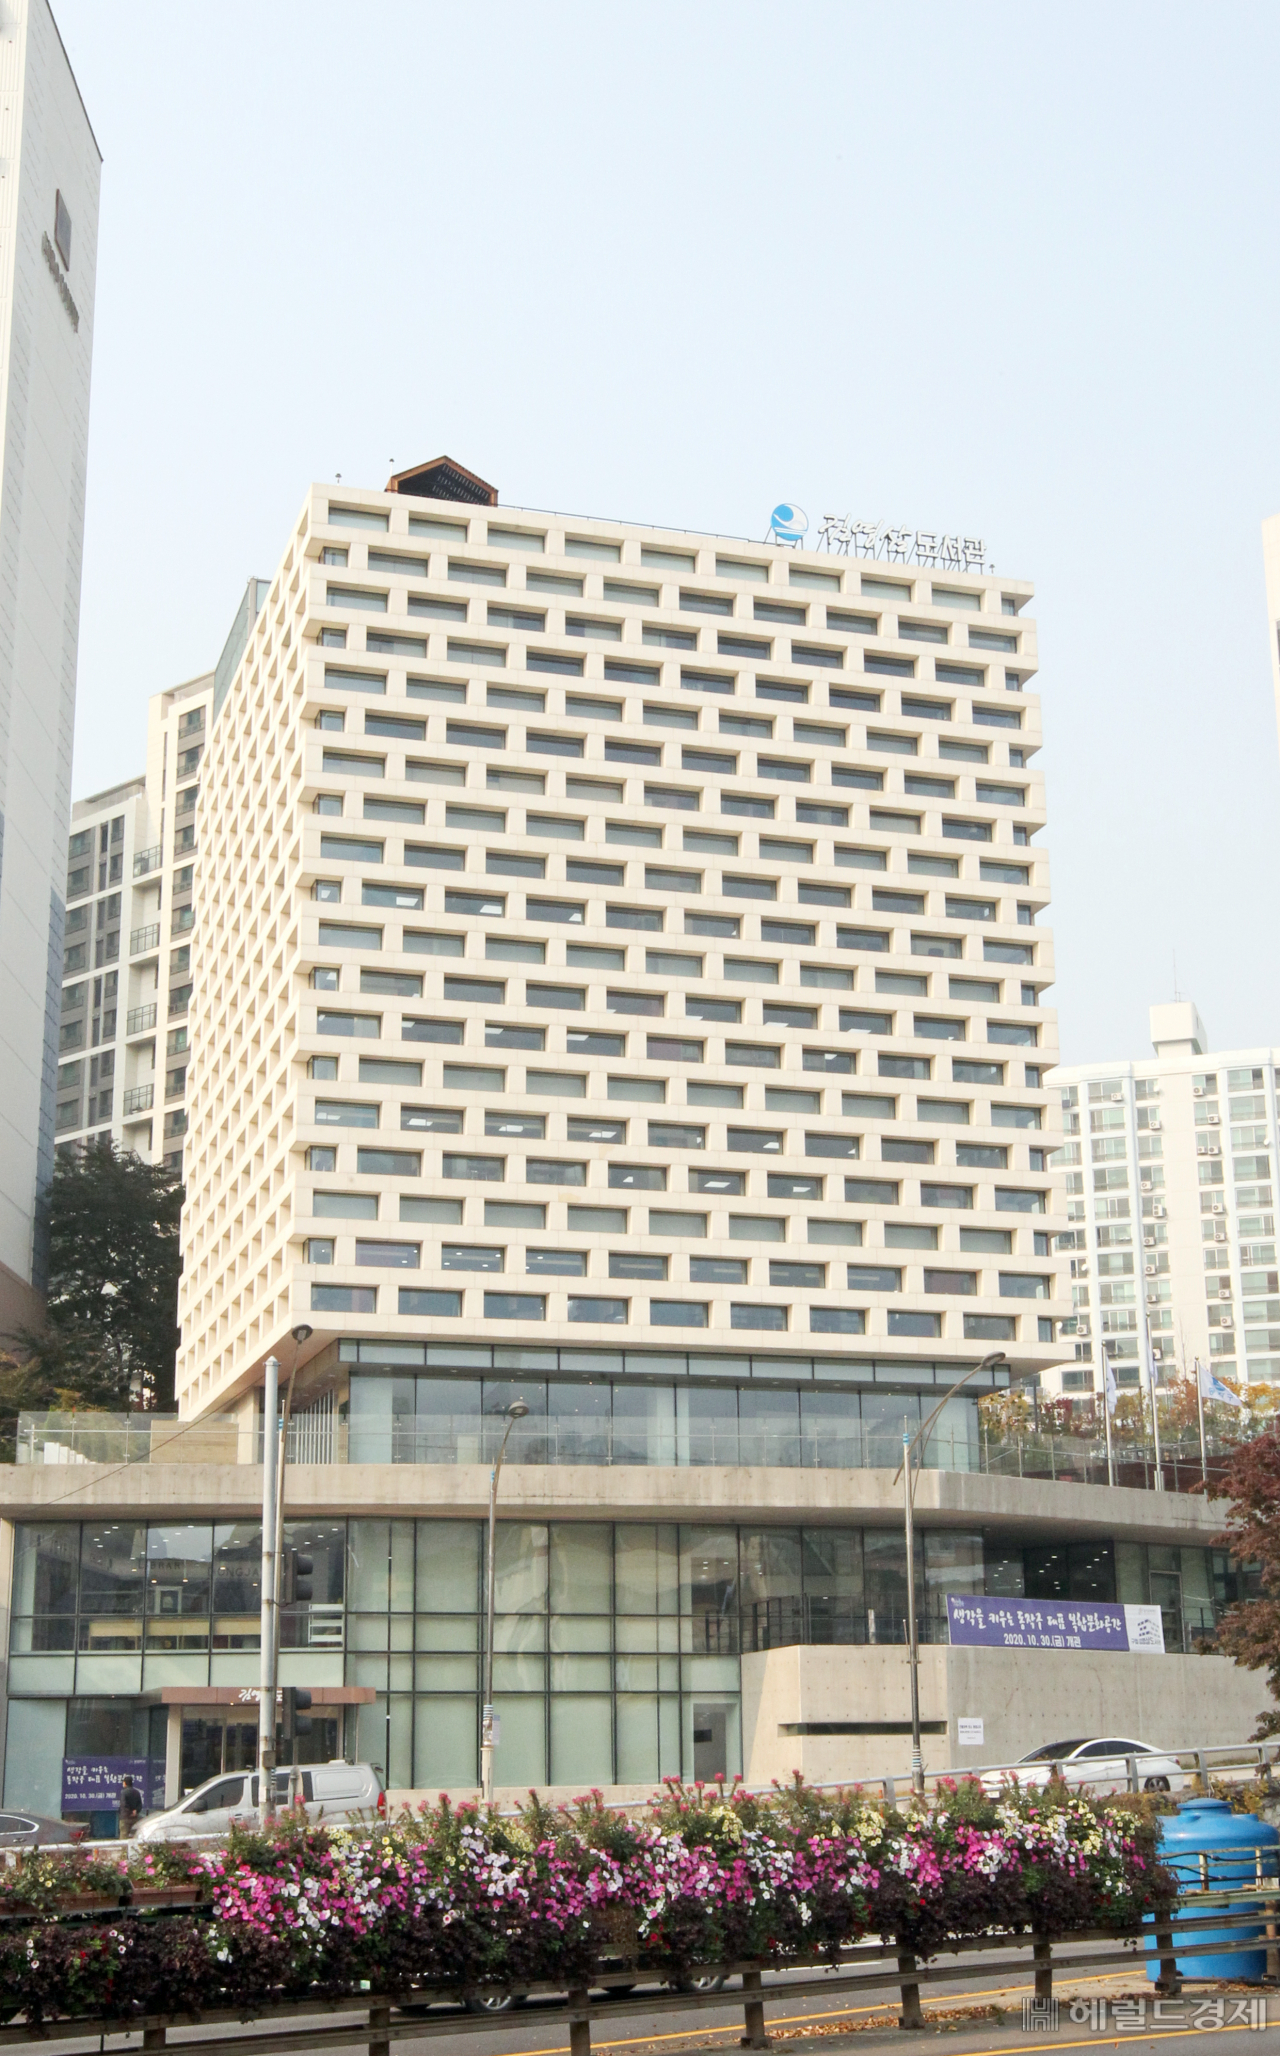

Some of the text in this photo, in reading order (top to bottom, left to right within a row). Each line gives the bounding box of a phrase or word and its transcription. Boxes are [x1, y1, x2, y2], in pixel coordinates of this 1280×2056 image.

[818, 513, 987, 564] 김영삼도서관
[953, 1607, 1122, 1633] 생각을 키우는 동작구 대표 복합문화공간
[1003, 1633, 1026, 1646] 2020.
[1027, 1634, 1039, 1646] 10.
[1066, 1636, 1082, 1648] 개관
